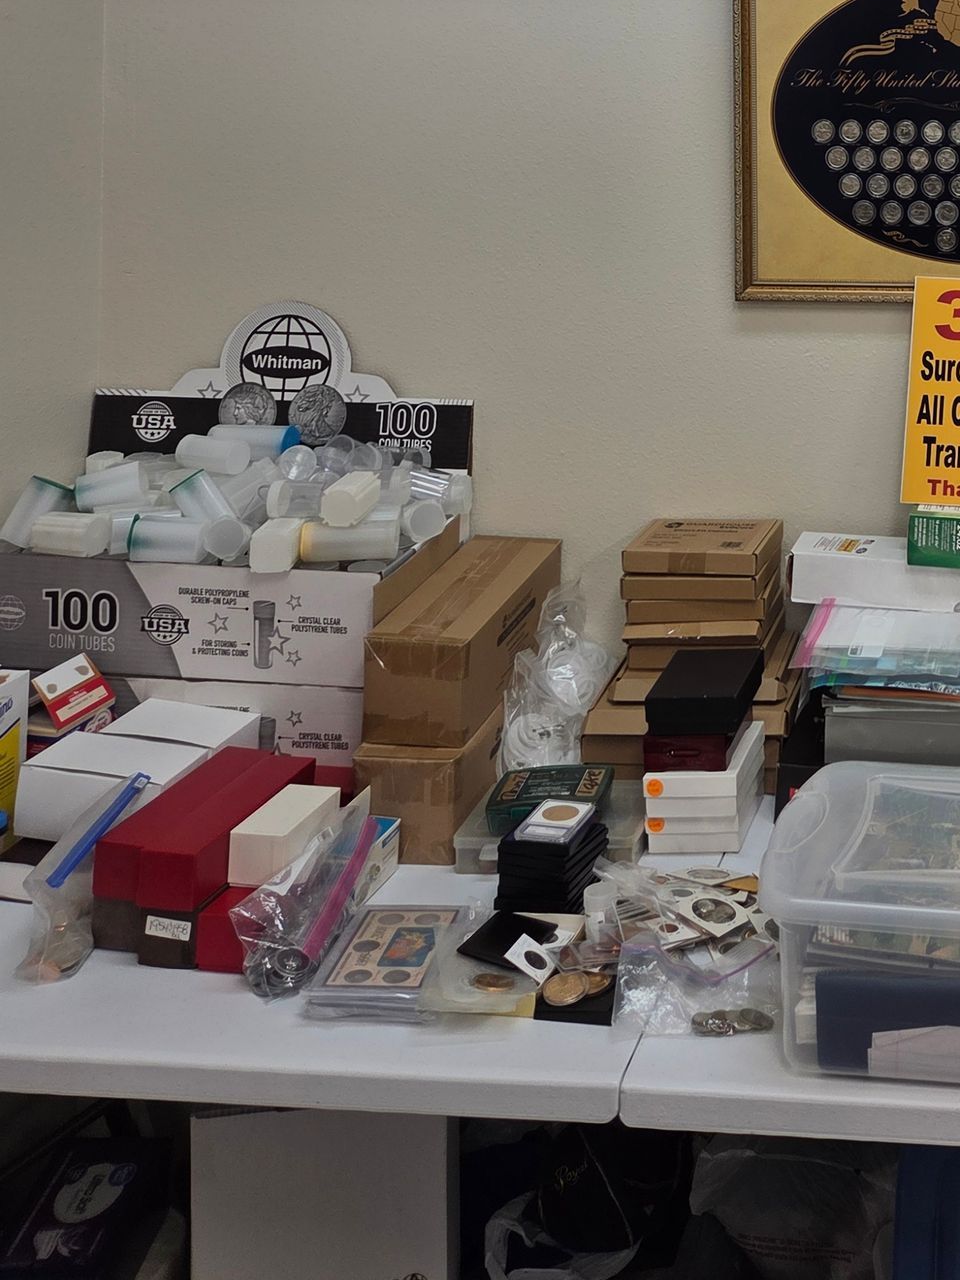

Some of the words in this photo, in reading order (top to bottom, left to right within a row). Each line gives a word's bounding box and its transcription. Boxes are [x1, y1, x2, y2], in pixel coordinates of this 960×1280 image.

[790, 68, 823, 88] The
[827, 69, 871, 95] Fifty
[873, 70, 932, 88] United
[252, 354, 323, 371] Whitman
[916, 394, 944, 426] All
[131, 414, 177, 429] USA
[375, 402, 437, 438] 100
[178, 587, 204, 596] DURABLE
[204, 588, 250, 598] POLYPROPYLENE
[191, 596, 221, 605] SCREW-ON
[42, 588, 120, 634] 100
[142, 618, 188, 632] USA
[298, 616, 321, 625] CRYSTAL
[323, 618, 341, 626] CLEAR
[291, 624, 329, 634] POLYSTYRENE
[330, 626, 348, 634] TUBES
[49, 633, 75, 649] COIN
[79, 635, 116, 652] TUBES
[201, 639, 213, 647] FOR
[214, 639, 237, 648] STORING
[197, 647, 231, 656] PROTECTING
[231, 648, 249, 657] COINS
[299, 732, 322, 741] CRYSTAL
[323, 733, 342, 741] CLEAR
[291, 741, 330, 750] POLYSTYRENE
